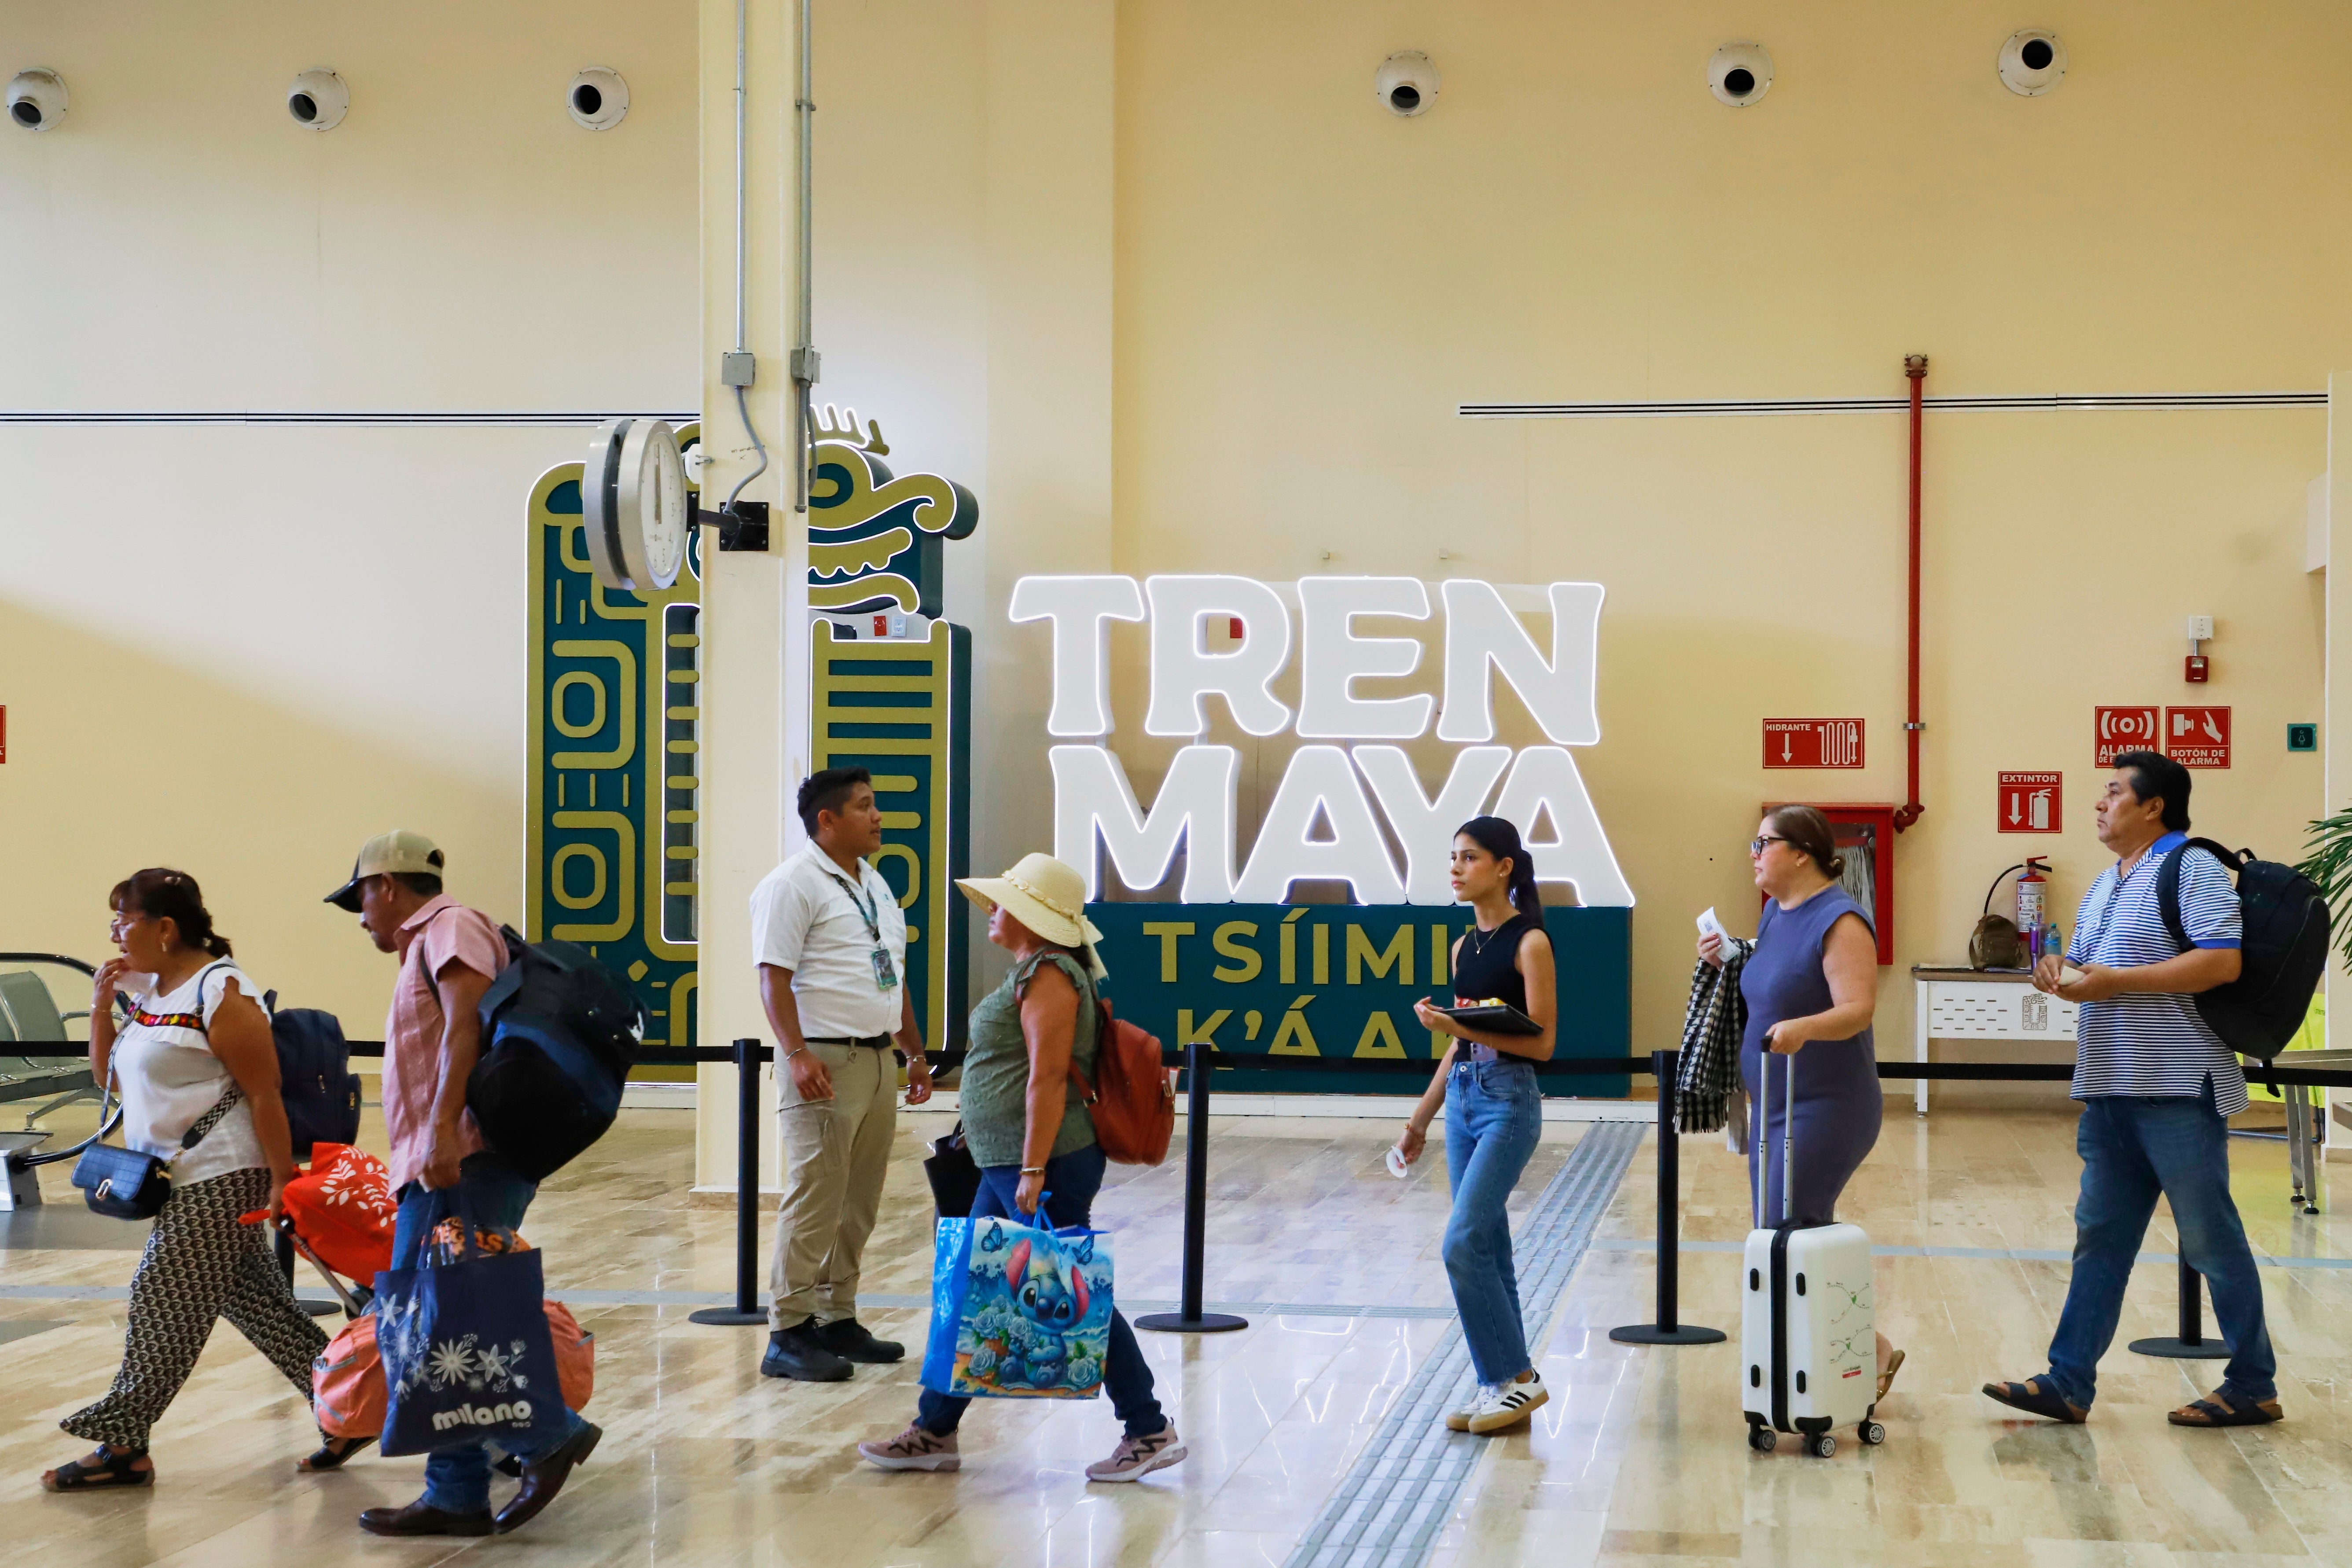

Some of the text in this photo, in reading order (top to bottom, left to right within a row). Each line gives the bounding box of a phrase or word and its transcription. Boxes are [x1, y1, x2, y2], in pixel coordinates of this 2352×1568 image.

[1009, 574, 1605, 745] TREN
[2171, 748, 2208, 757] BOTÓN
[1048, 745, 1636, 907] MAYA
[1143, 907, 1477, 985] TSÍIMI
[432, 1400, 532, 1431] milano
